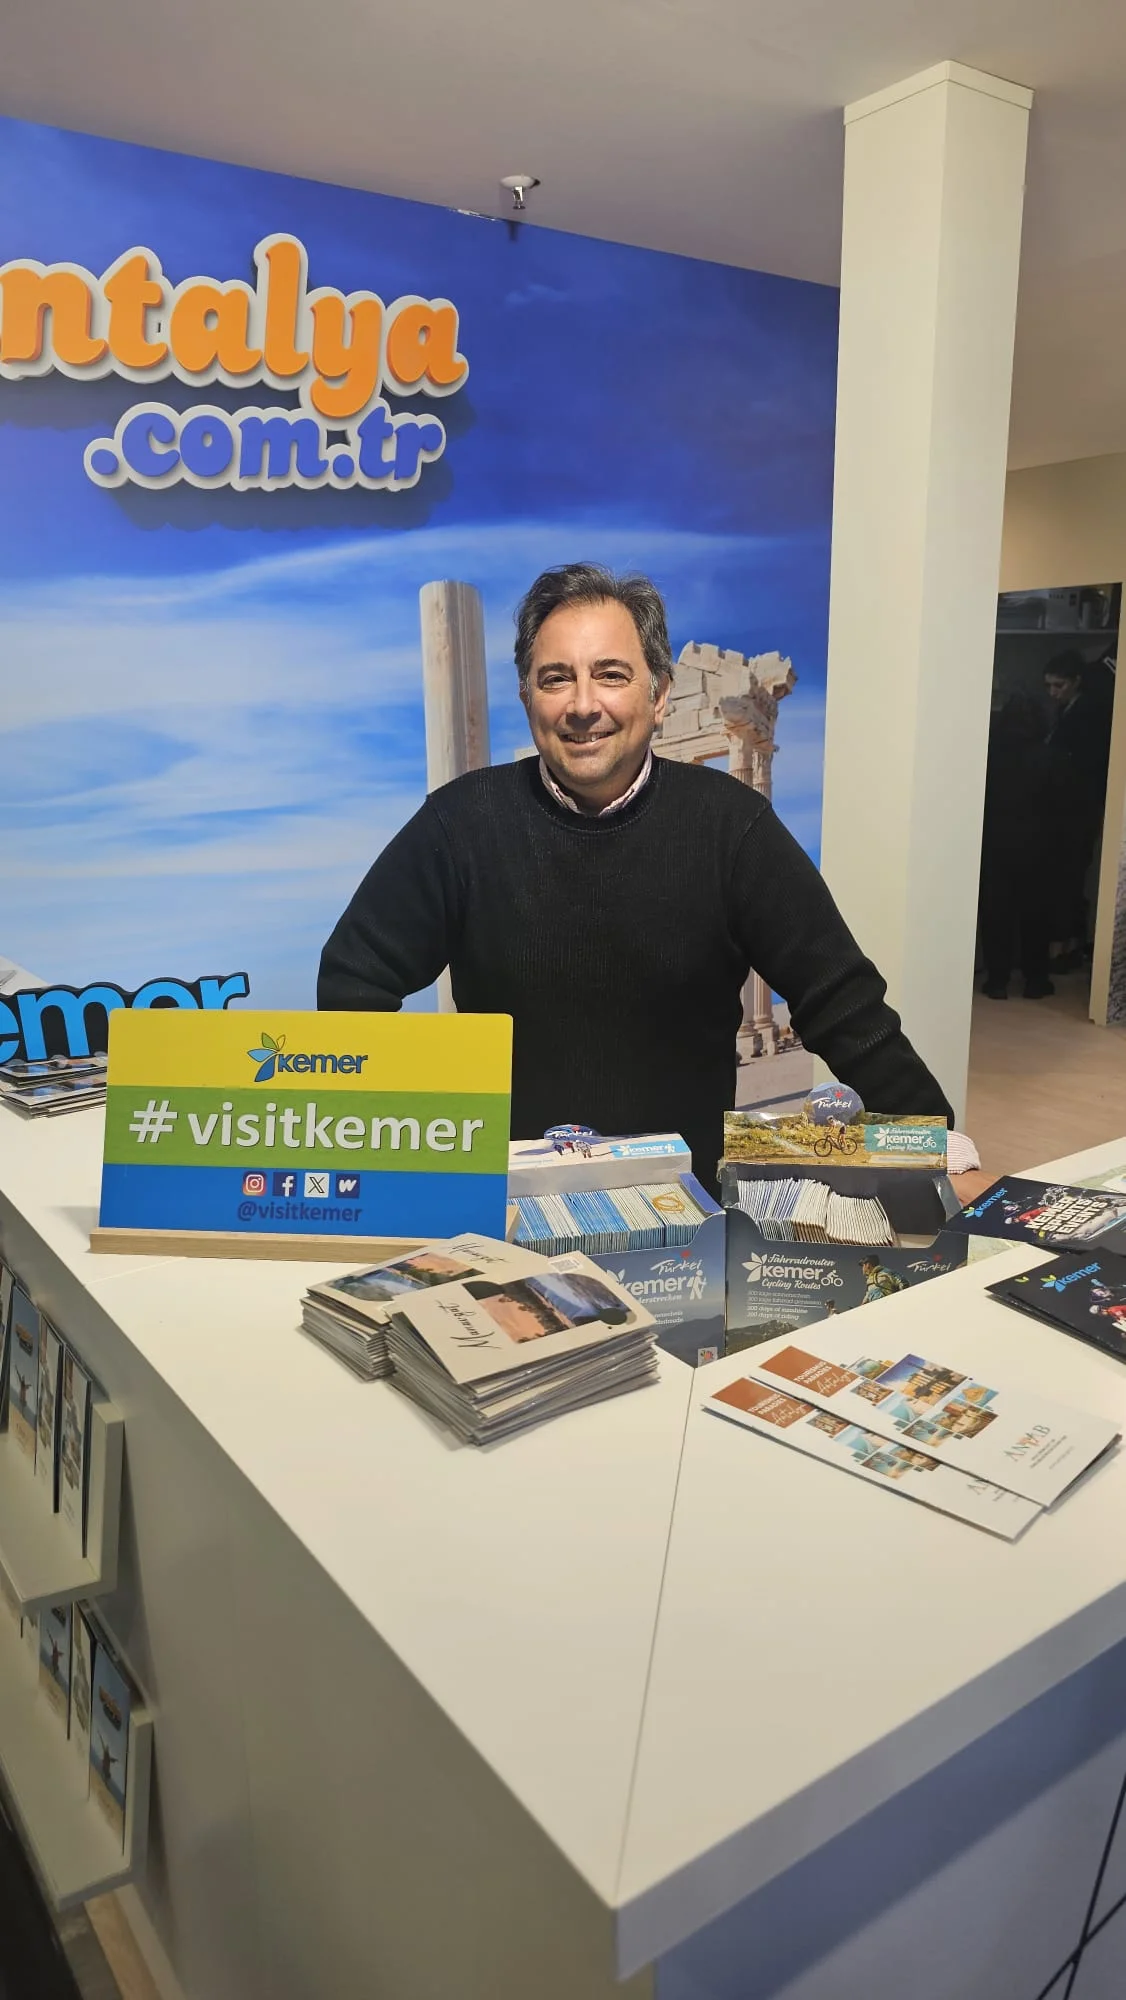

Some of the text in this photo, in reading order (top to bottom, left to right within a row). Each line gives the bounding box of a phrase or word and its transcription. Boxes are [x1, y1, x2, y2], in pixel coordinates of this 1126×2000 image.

[90, 407, 444, 481] .com.tr
[278, 1053, 369, 1073] kemer
[887, 1135, 924, 1144] kemer
[237, 1200, 363, 1222] @visitkemer
[978, 1187, 1008, 1212] kemer
[1024, 1196, 1077, 1229] KEMER
[1041, 1199, 1093, 1232] SPORTS
[1056, 1201, 1108, 1233] EVENTS
[761, 1278, 821, 1290] Cycling Routes
[762, 1265, 823, 1280] kemer
[1060, 1262, 1101, 1285] kemer
